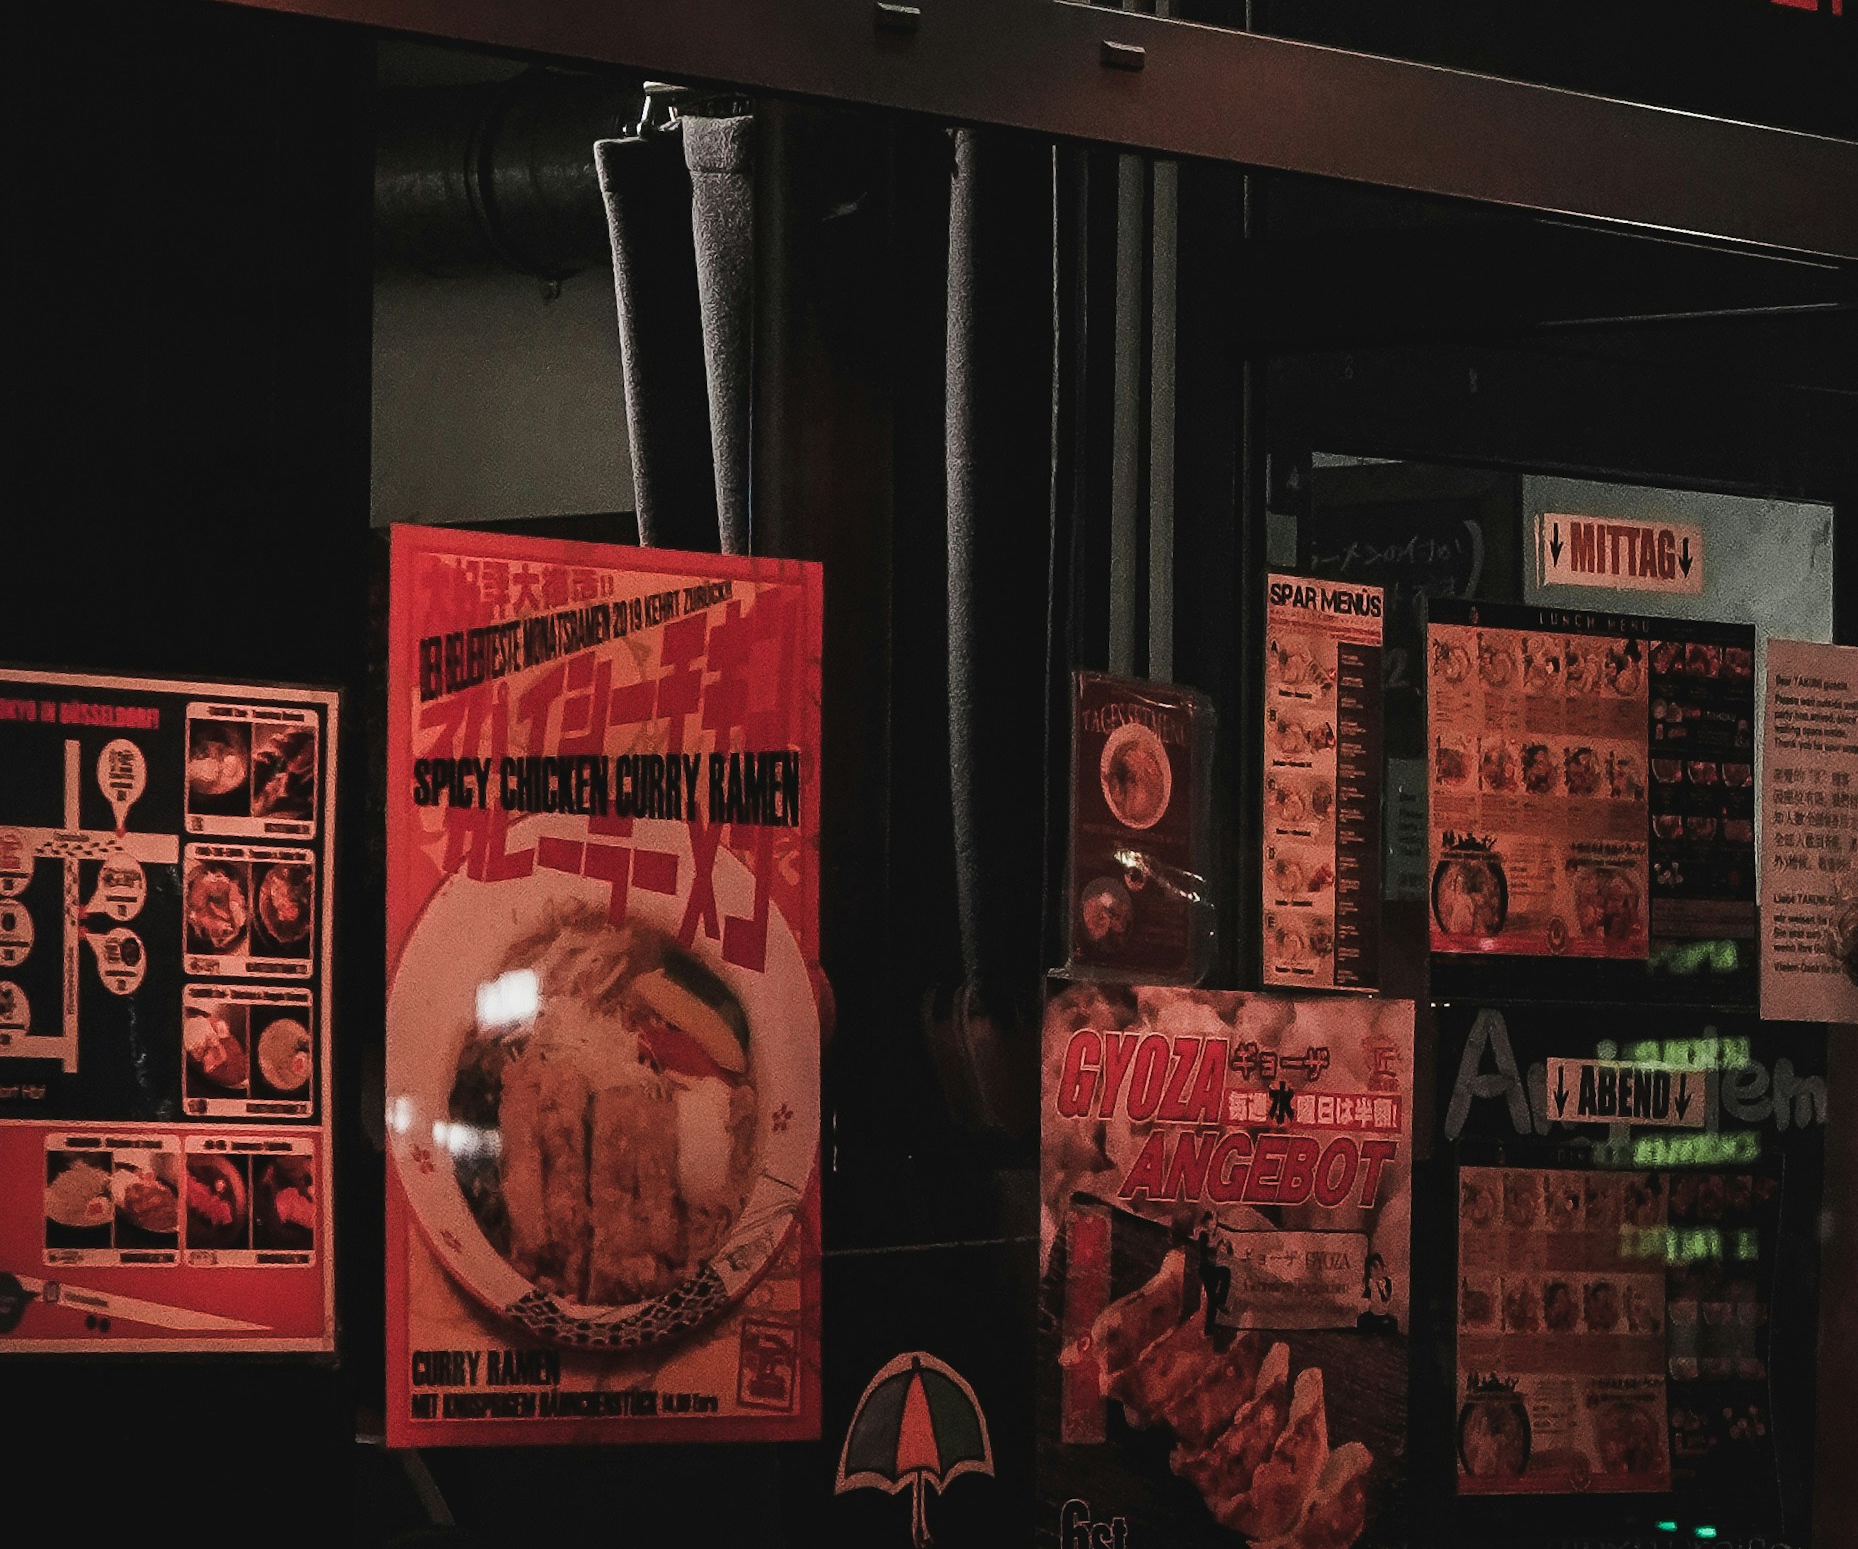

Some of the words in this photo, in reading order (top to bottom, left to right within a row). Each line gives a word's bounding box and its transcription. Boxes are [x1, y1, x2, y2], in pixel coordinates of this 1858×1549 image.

[1569, 521, 1676, 580] MITTAG
[612, 597, 643, 639] 2019
[1269, 583, 1318, 610] SPAR
[1319, 588, 1382, 619] MENÜS
[1538, 611, 1595, 630] LUNCH
[413, 756, 492, 809] SPICY
[498, 753, 609, 815] CHICKEN
[615, 751, 701, 822] CURRY
[708, 748, 800, 827] RAMEN
[1056, 1027, 1230, 1126] GYOZA
[1577, 1065, 1671, 1120] ABEND
[1117, 1127, 1401, 1209] ANGEBOT
